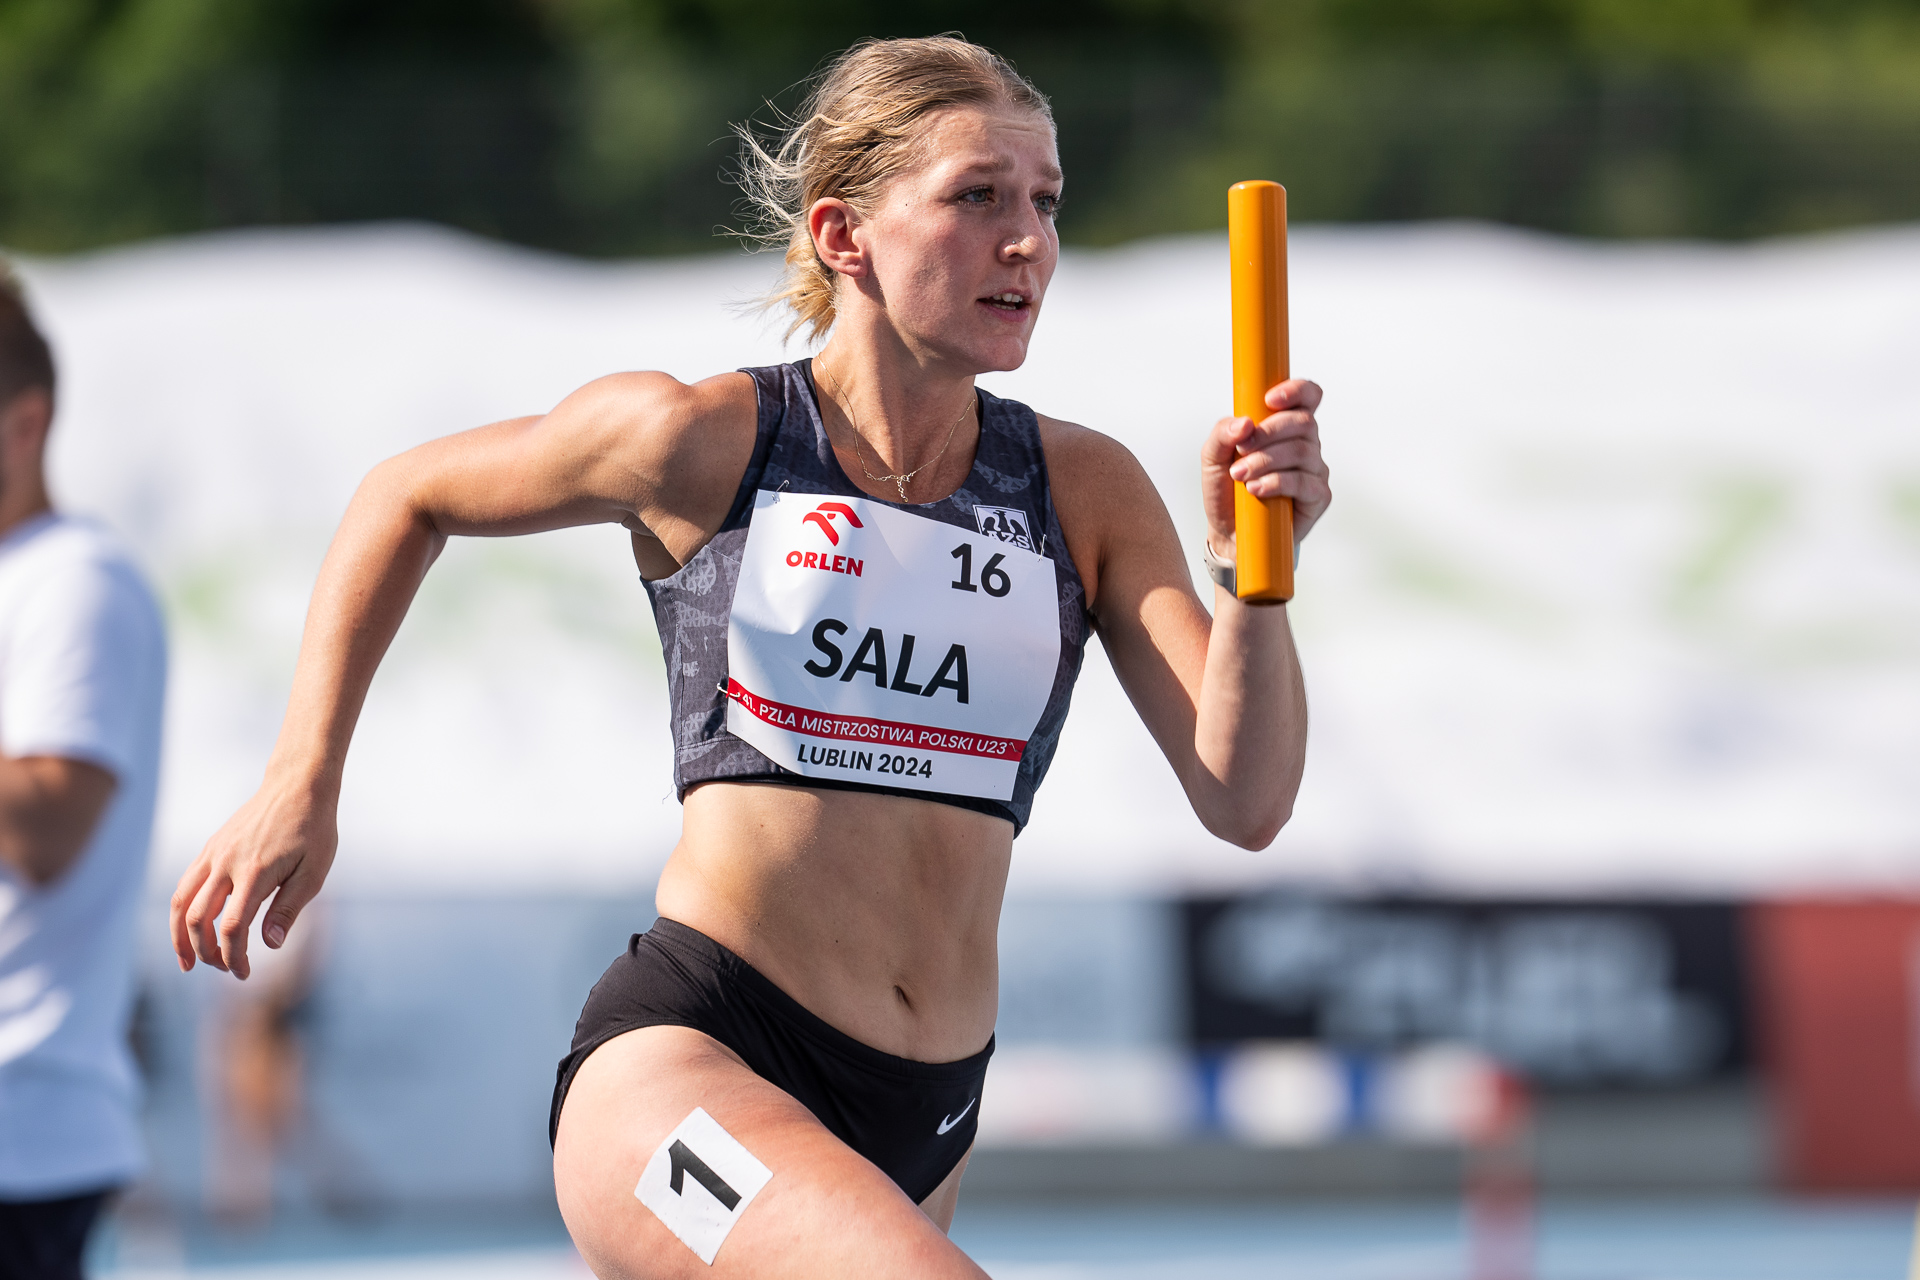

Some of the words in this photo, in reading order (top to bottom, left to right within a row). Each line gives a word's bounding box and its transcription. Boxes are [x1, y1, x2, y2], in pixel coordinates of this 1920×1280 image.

[786, 551, 864, 577] ORLEN
[951, 543, 1011, 597] 16
[803, 618, 969, 704] SALA
[742, 693, 757, 712] 41.
[760, 703, 796, 727] PZLA
[802, 715, 914, 744] MISTRZOSTWA
[918, 731, 974, 751] POLSKI
[976, 739, 1008, 754] U23
[797, 743, 873, 771] LUBLIN
[877, 753, 932, 778] 2024
[668, 1138, 742, 1212] 1
